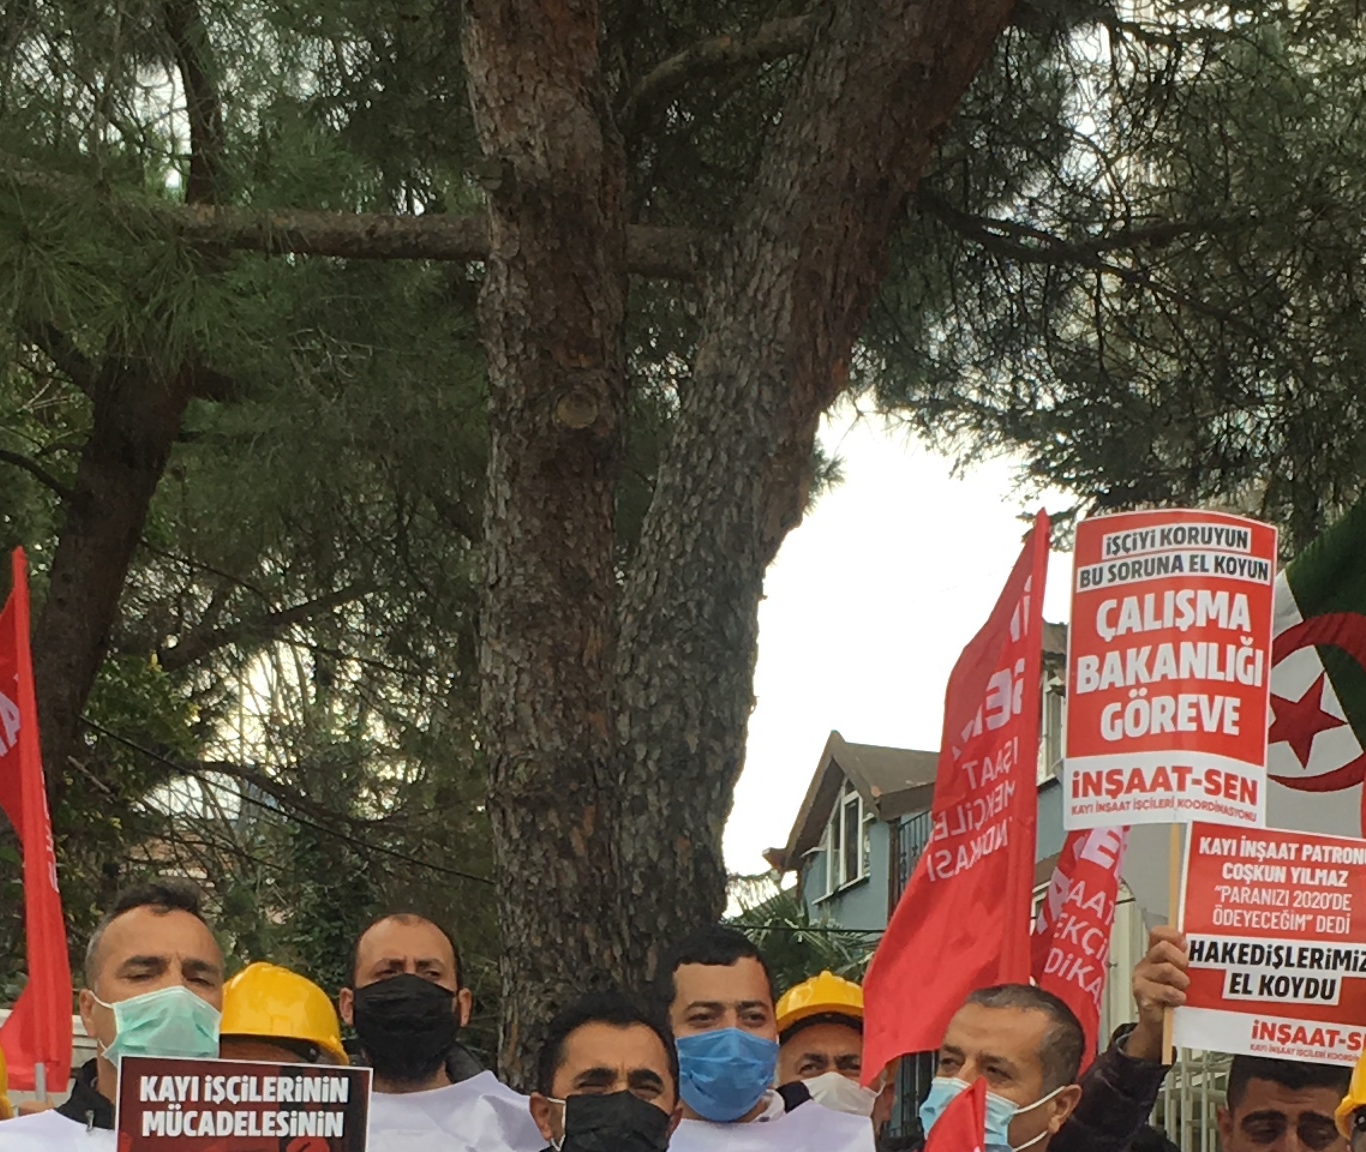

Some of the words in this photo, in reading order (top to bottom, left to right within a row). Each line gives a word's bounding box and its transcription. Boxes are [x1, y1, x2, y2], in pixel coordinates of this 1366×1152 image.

[1159, 526, 1248, 550] KORUYUN
[1079, 566, 1104, 589] BU
[1107, 555, 1183, 583] SORUNA
[1189, 556, 1210, 574] EL
[1214, 557, 1269, 581] KOYUN
[1096, 589, 1251, 642] ÇALIŞMA
[1076, 636, 1264, 695] BAKANLIĞI
[1100, 687, 1241, 741] GÖREVE
[1199, 836, 1236, 856] KAYI
[1222, 863, 1287, 885] COŞKUN
[1291, 867, 1349, 888] YILMAZ
[1229, 973, 1253, 995] EL
[1258, 975, 1336, 1000] KOYDU
[140, 1076, 199, 1102] KAYI
